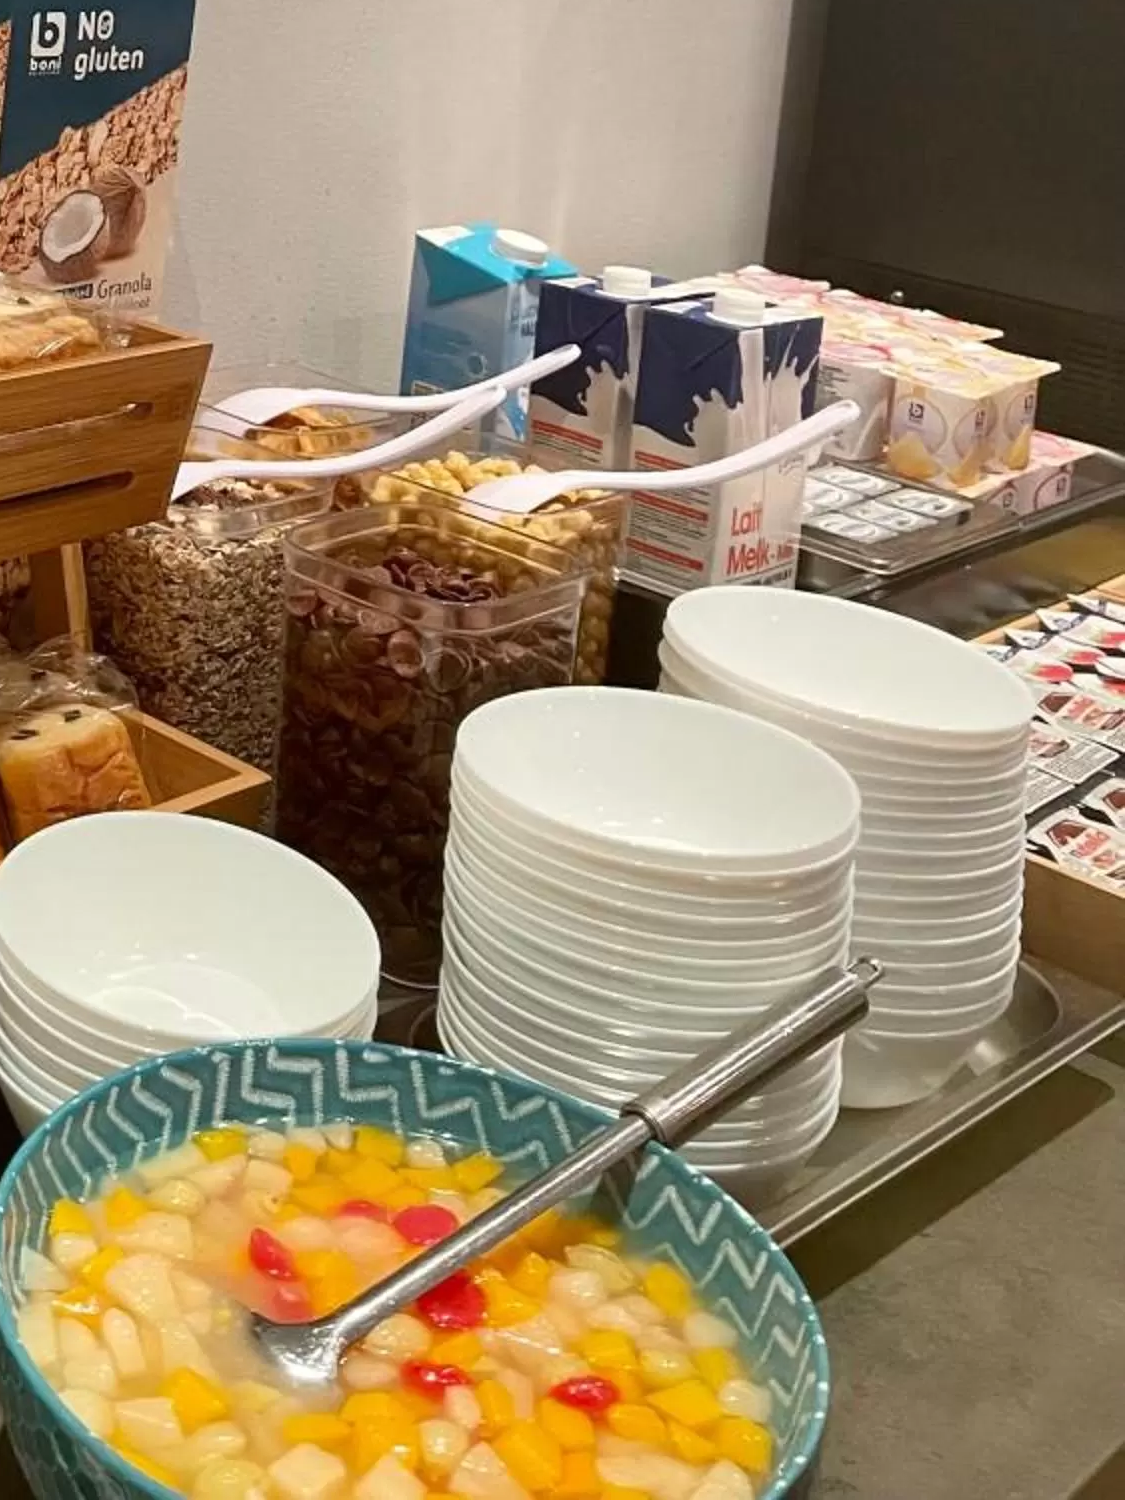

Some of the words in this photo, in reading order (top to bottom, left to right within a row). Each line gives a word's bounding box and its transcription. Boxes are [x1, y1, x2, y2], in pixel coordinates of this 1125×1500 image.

[30, 56, 62, 71] boni
[74, 45, 144, 80] gluten
[97, 271, 152, 299] Granola
[726, 536, 770, 576] Melk
